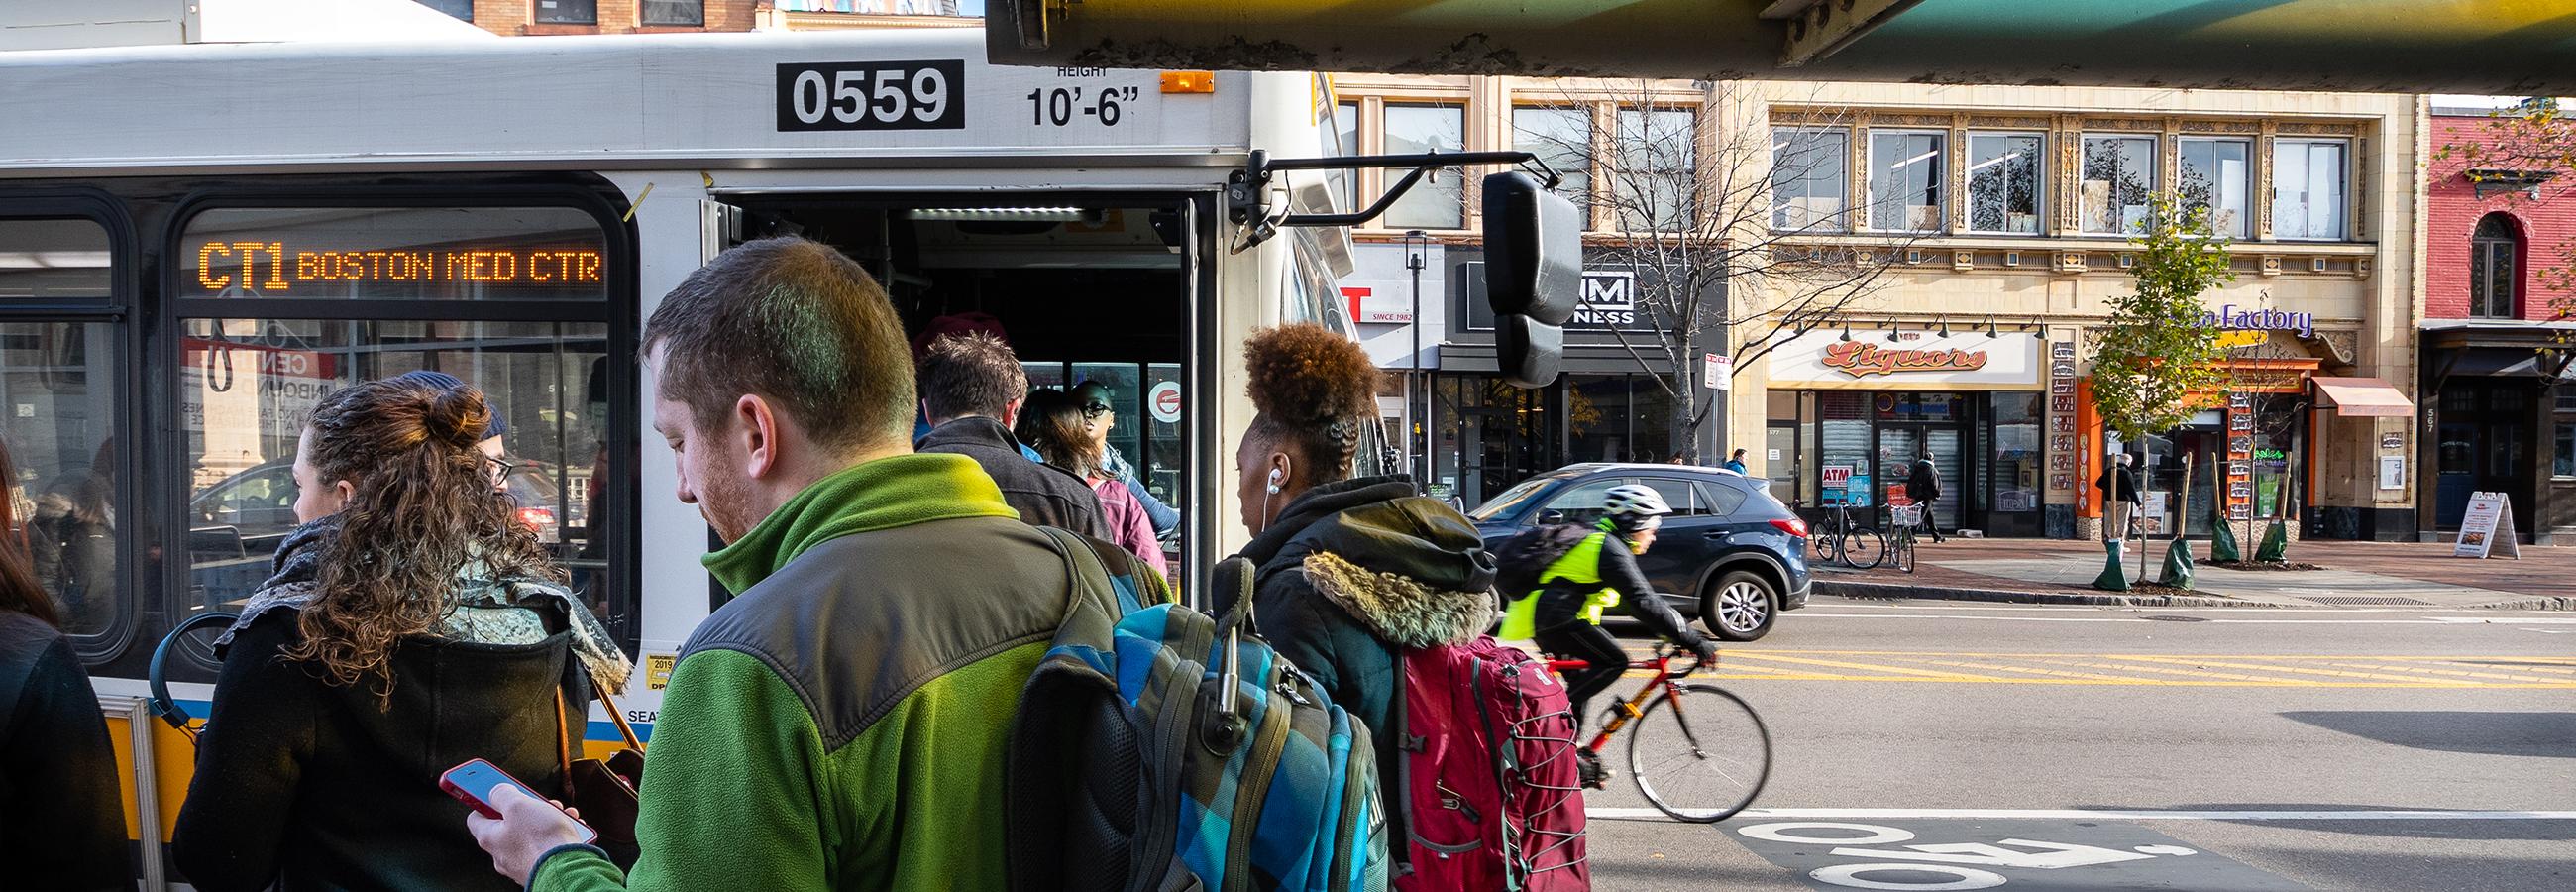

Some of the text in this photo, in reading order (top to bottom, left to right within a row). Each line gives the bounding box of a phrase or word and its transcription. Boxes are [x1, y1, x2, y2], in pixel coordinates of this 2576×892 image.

[1057, 65, 1107, 77] HEIGHT
[793, 68, 948, 124] 0559
[199, 241, 601, 290] CT1 BOSTON MED CTR
[2222, 303, 2312, 338] Factory
[1821, 340, 1987, 375] Liquors
[1823, 469, 1849, 481] ATM
[654, 660, 673, 670] 2019
[628, 710, 659, 723] SEA
